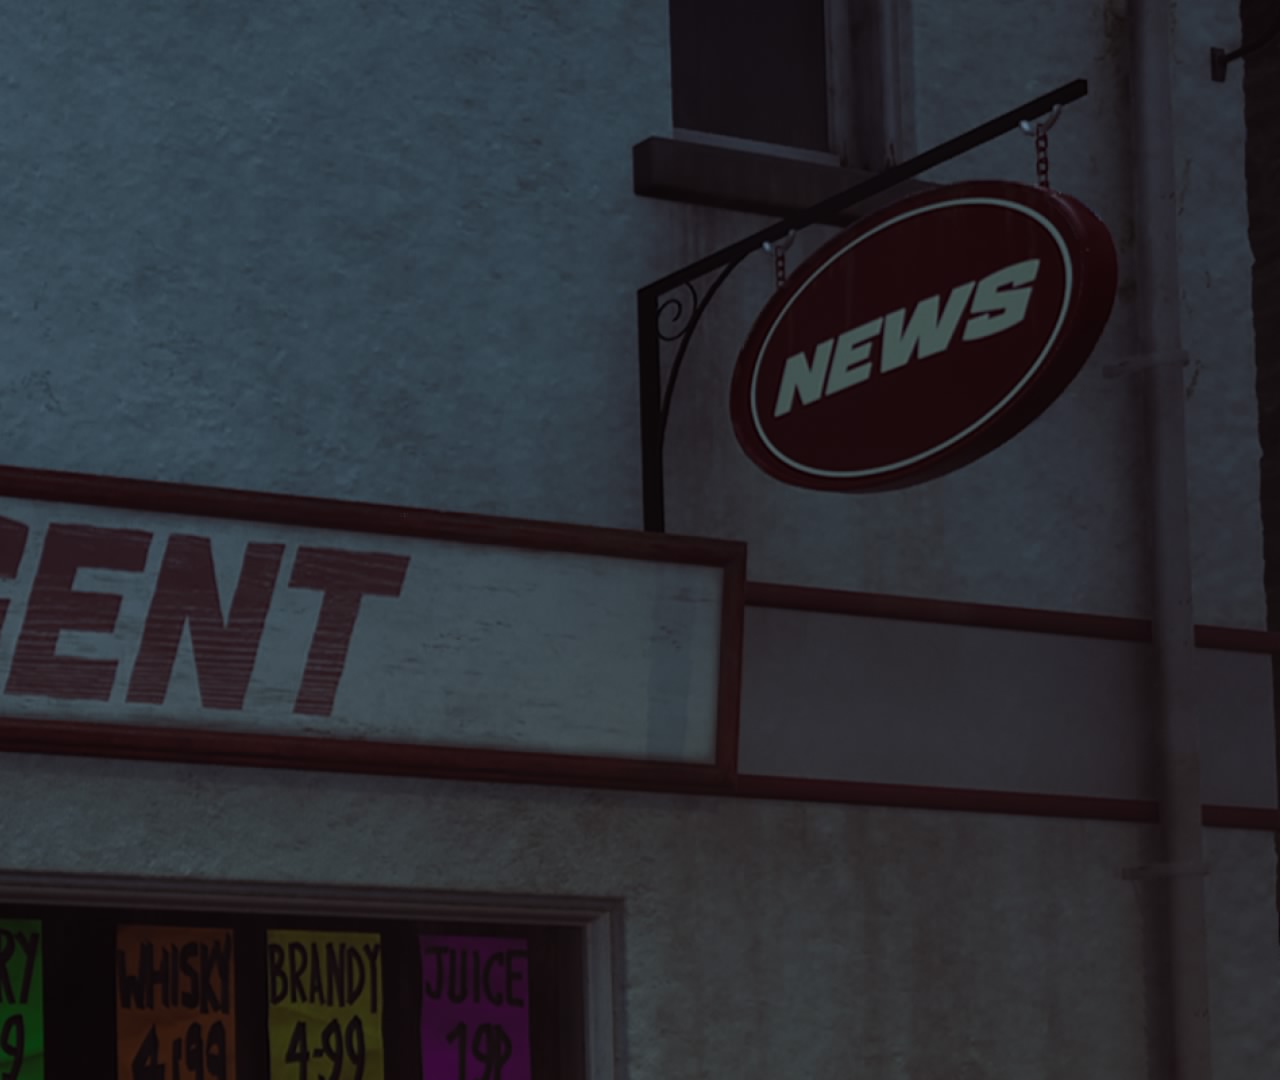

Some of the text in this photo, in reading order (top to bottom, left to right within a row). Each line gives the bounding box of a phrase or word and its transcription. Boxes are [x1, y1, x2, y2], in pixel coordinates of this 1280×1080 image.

[774, 258, 1040, 418] NEWS
[119, 932, 232, 1014] WHISKY
[268, 942, 382, 1013] BRANDY
[425, 946, 528, 1007] JUICE
